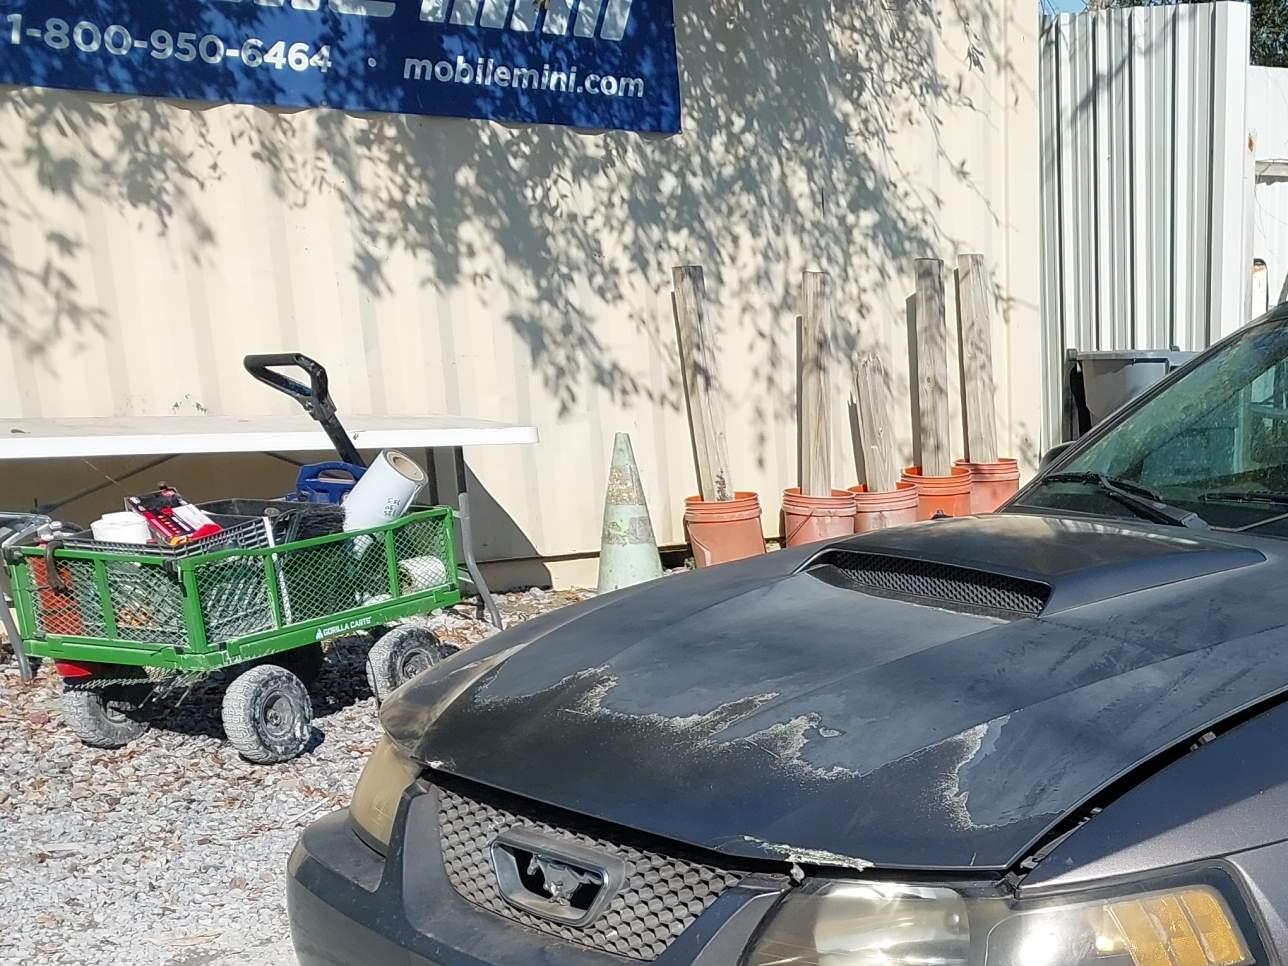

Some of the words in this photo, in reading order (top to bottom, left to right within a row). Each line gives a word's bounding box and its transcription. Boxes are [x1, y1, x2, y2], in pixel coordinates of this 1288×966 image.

[6, 13, 332, 72] 1-800-950-6464
[403, 56, 645, 98] mobilemini.com
[323, 623, 350, 636] GORILLA
[350, 617, 371, 629] CARTS
